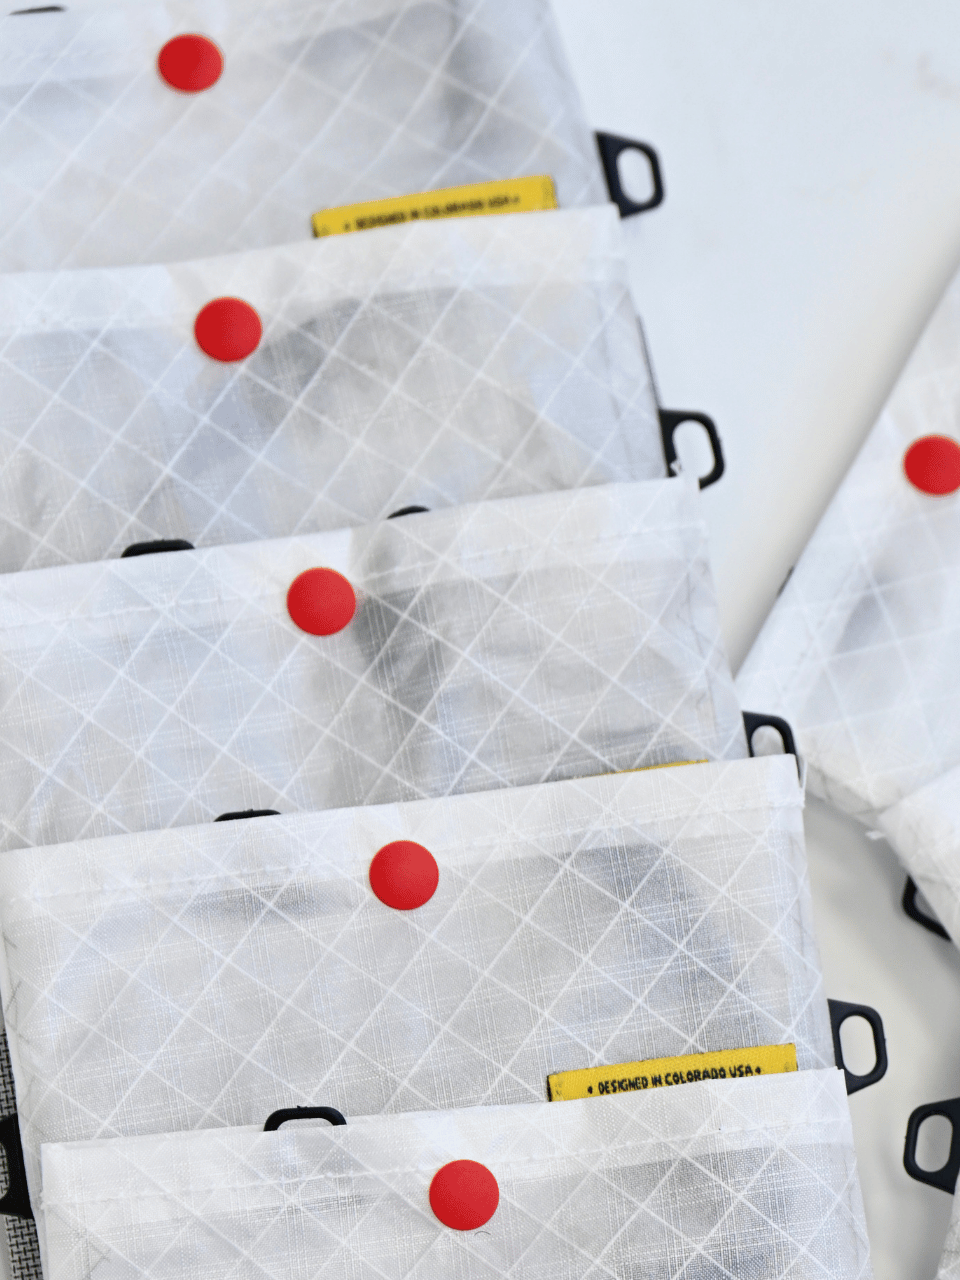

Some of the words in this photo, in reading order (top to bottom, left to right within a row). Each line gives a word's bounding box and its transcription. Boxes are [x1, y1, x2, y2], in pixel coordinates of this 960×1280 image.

[598, 1076, 649, 1095] DESIGNED
[651, 1074, 663, 1087] IN
[664, 1066, 726, 1085] COLORADO
[728, 1064, 753, 1078] USA
